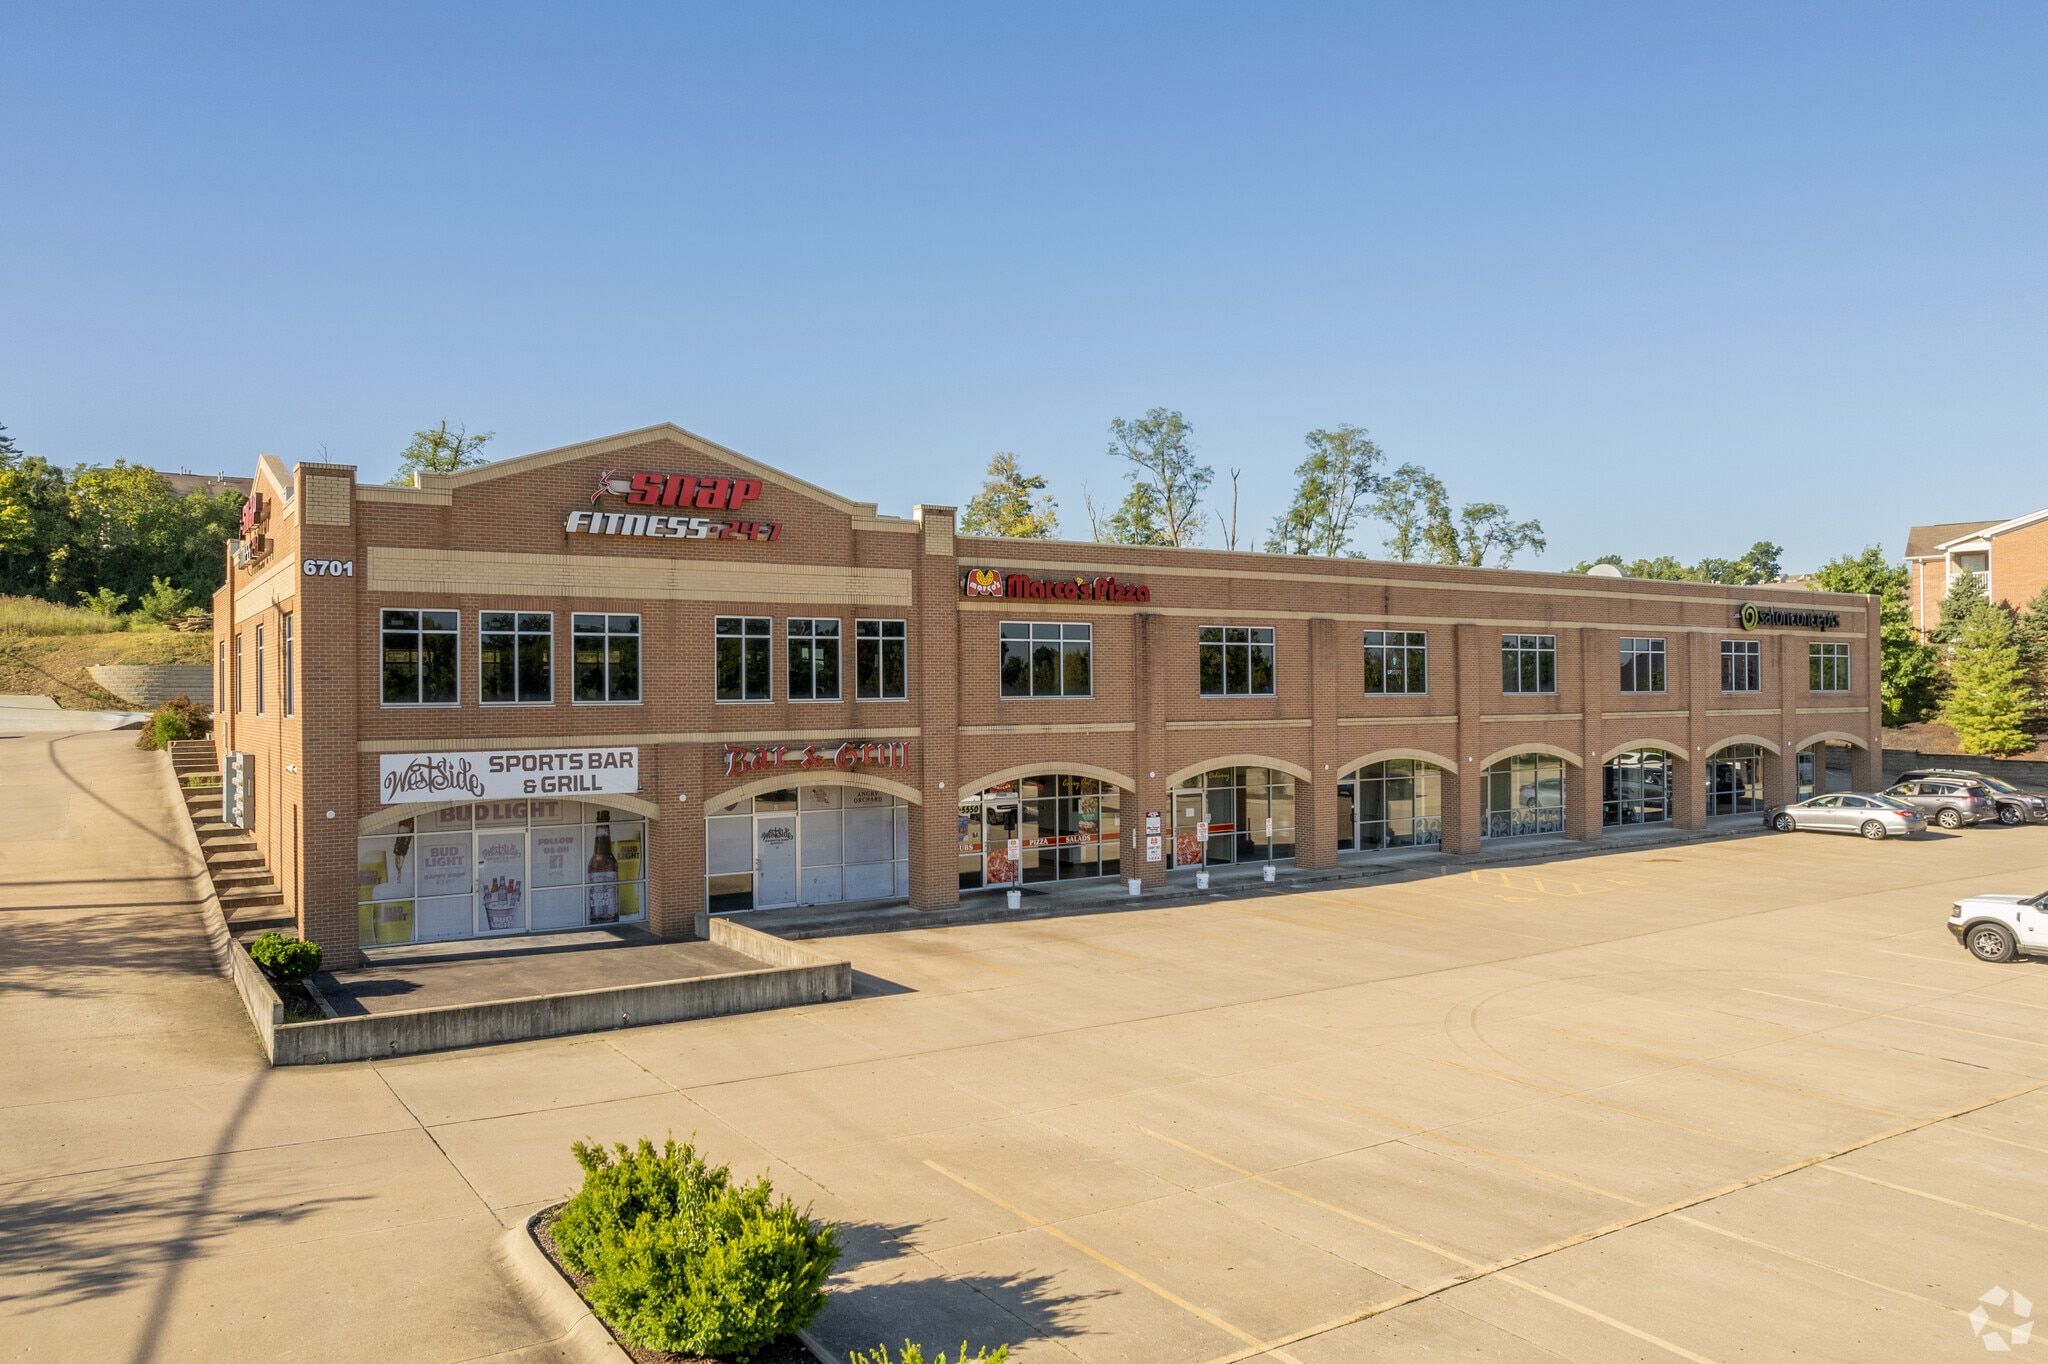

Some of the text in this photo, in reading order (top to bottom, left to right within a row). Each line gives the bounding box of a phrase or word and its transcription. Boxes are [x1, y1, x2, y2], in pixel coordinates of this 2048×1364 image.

[303, 560, 353, 577] 6701
[1007, 574, 1150, 602] Marco's Pizza
[1760, 606, 1840, 631] salonconcepts
[489, 752, 634, 773] SPORTS BAR
[725, 741, 911, 776] Bar & Grill
[523, 774, 603, 793] & GRILL
[440, 801, 559, 823] BUD LIGHT
[538, 837, 573, 845] FOLLOW
[1065, 835, 1091, 843] SALADS
[425, 856, 464, 867] LIGHT
[430, 847, 459, 857] BUD
